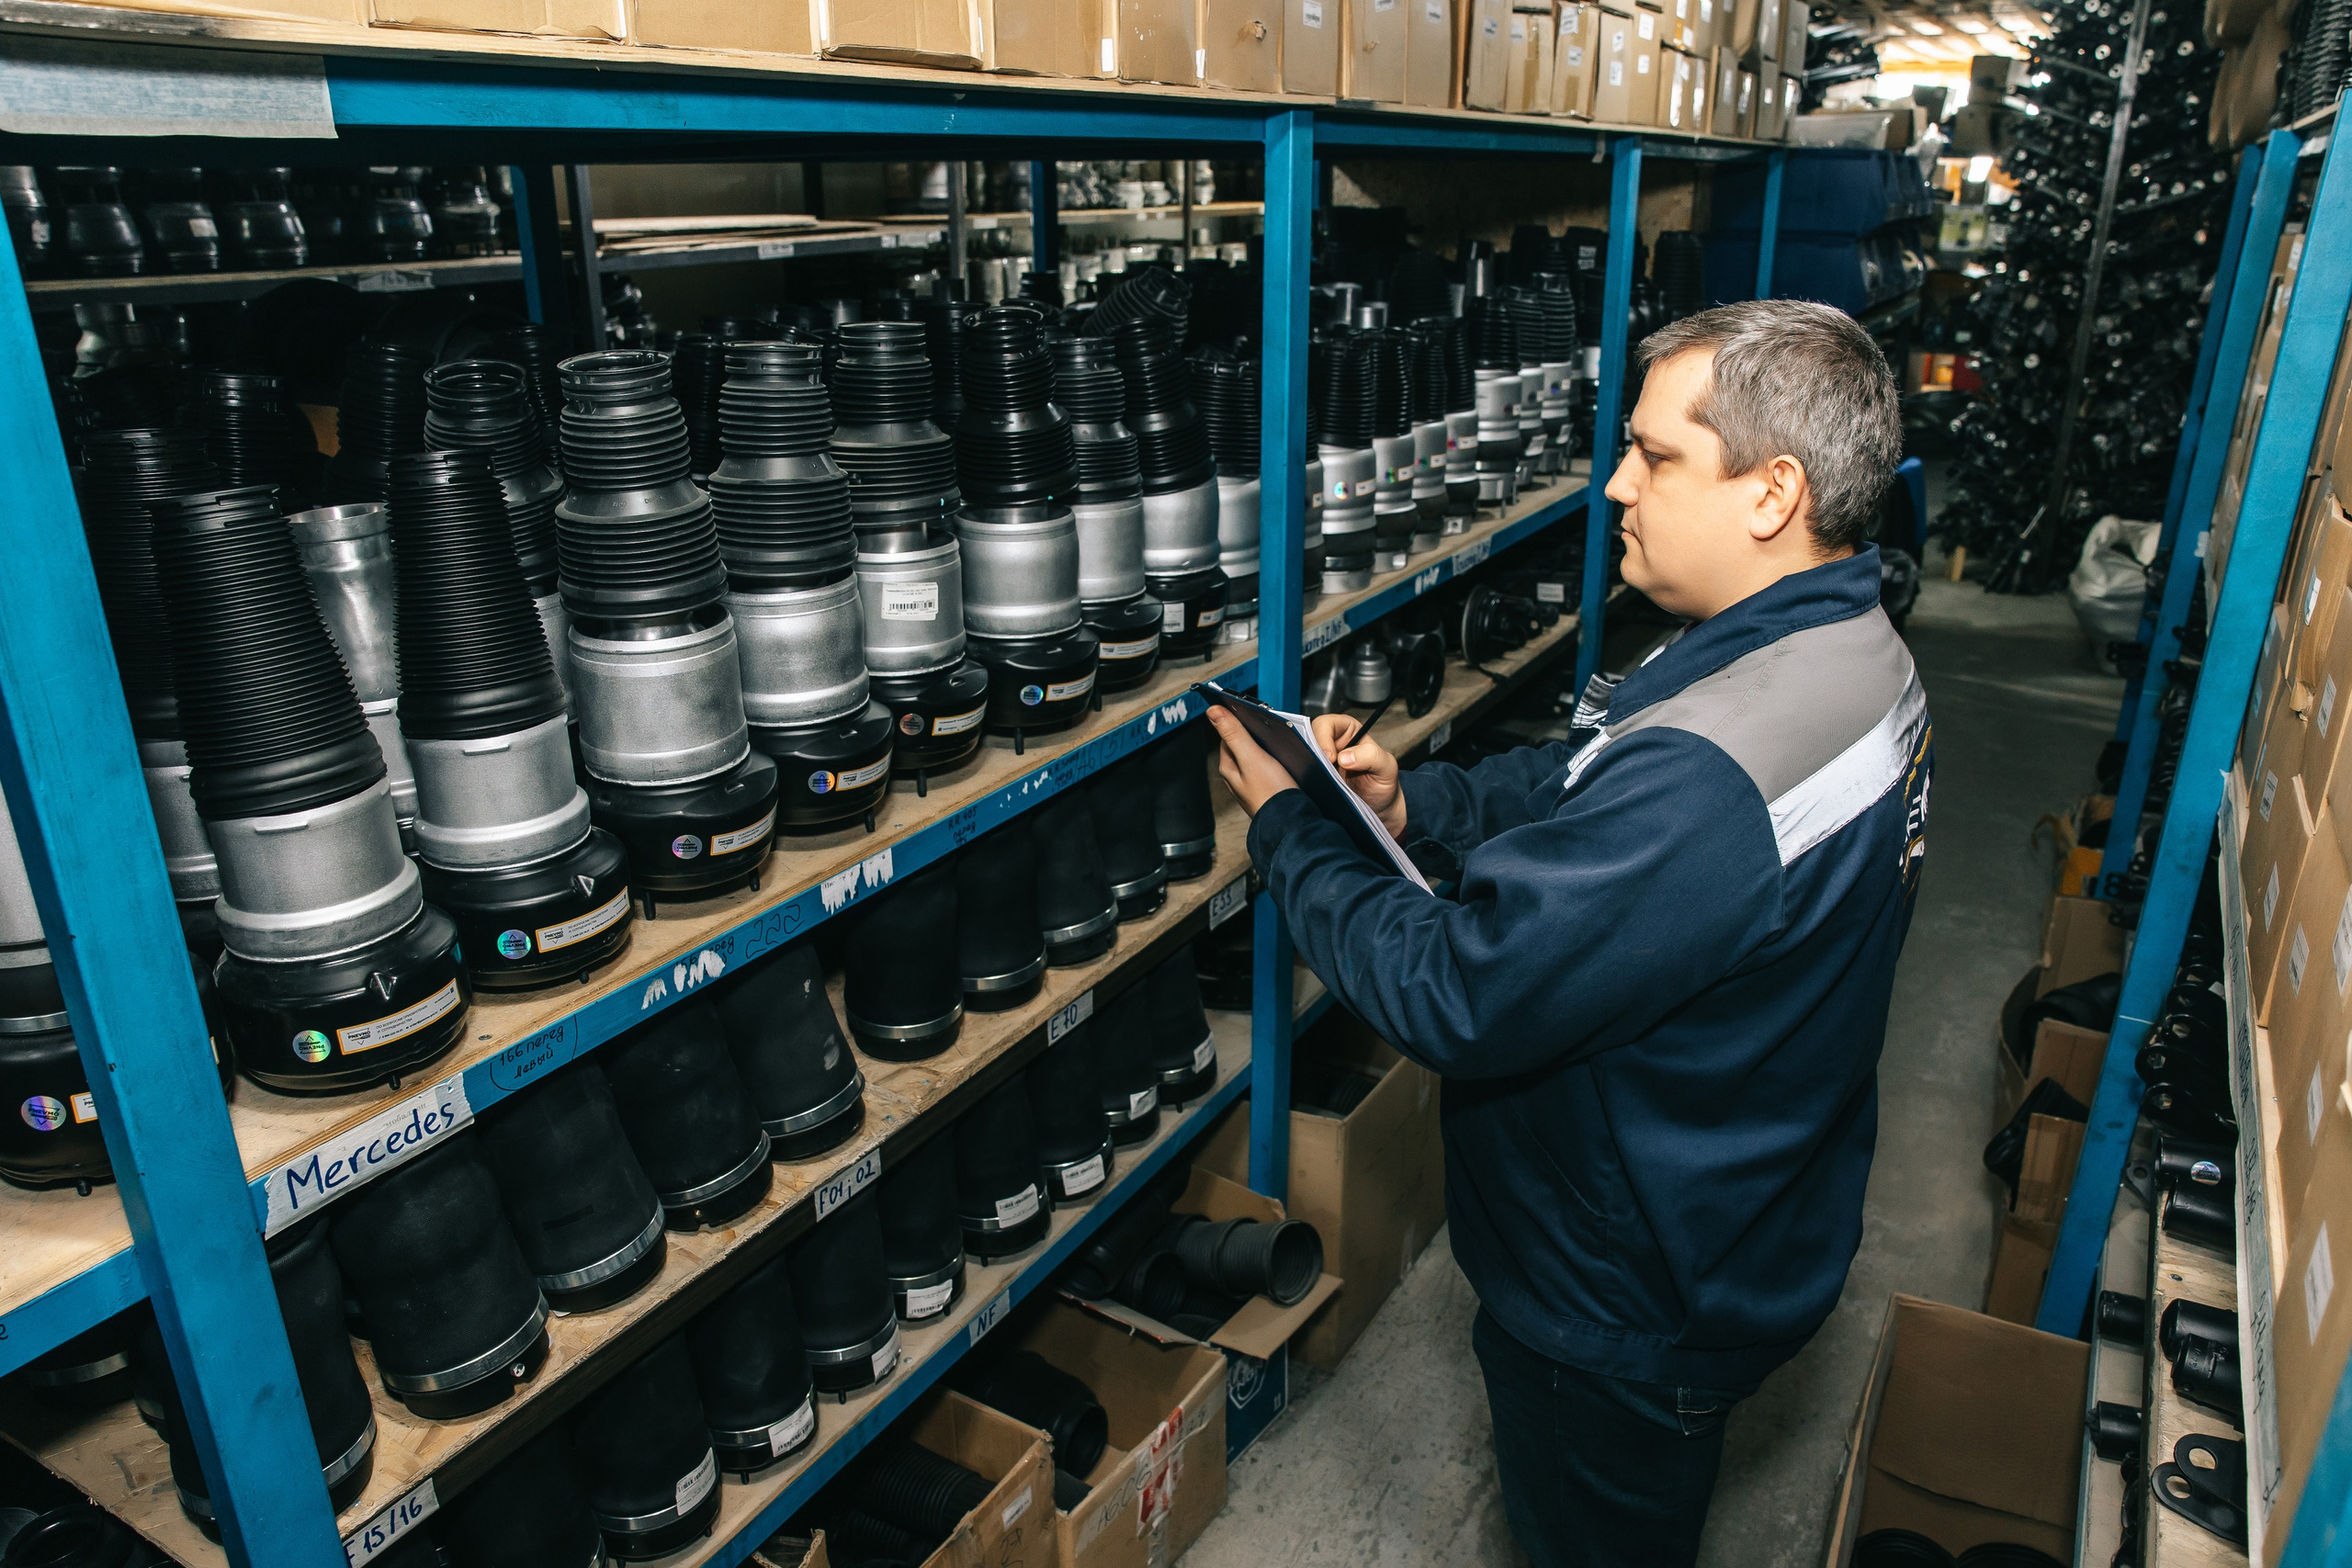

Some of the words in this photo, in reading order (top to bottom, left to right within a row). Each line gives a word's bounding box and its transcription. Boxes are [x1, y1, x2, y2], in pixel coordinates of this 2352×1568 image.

[526, 1025, 564, 1051] перед
[1051, 1016, 1060, 1040] E
[1063, 1003, 1078, 1029] 70
[287, 1102, 455, 1209] Mercedes
[977, 1303, 997, 1337] NF
